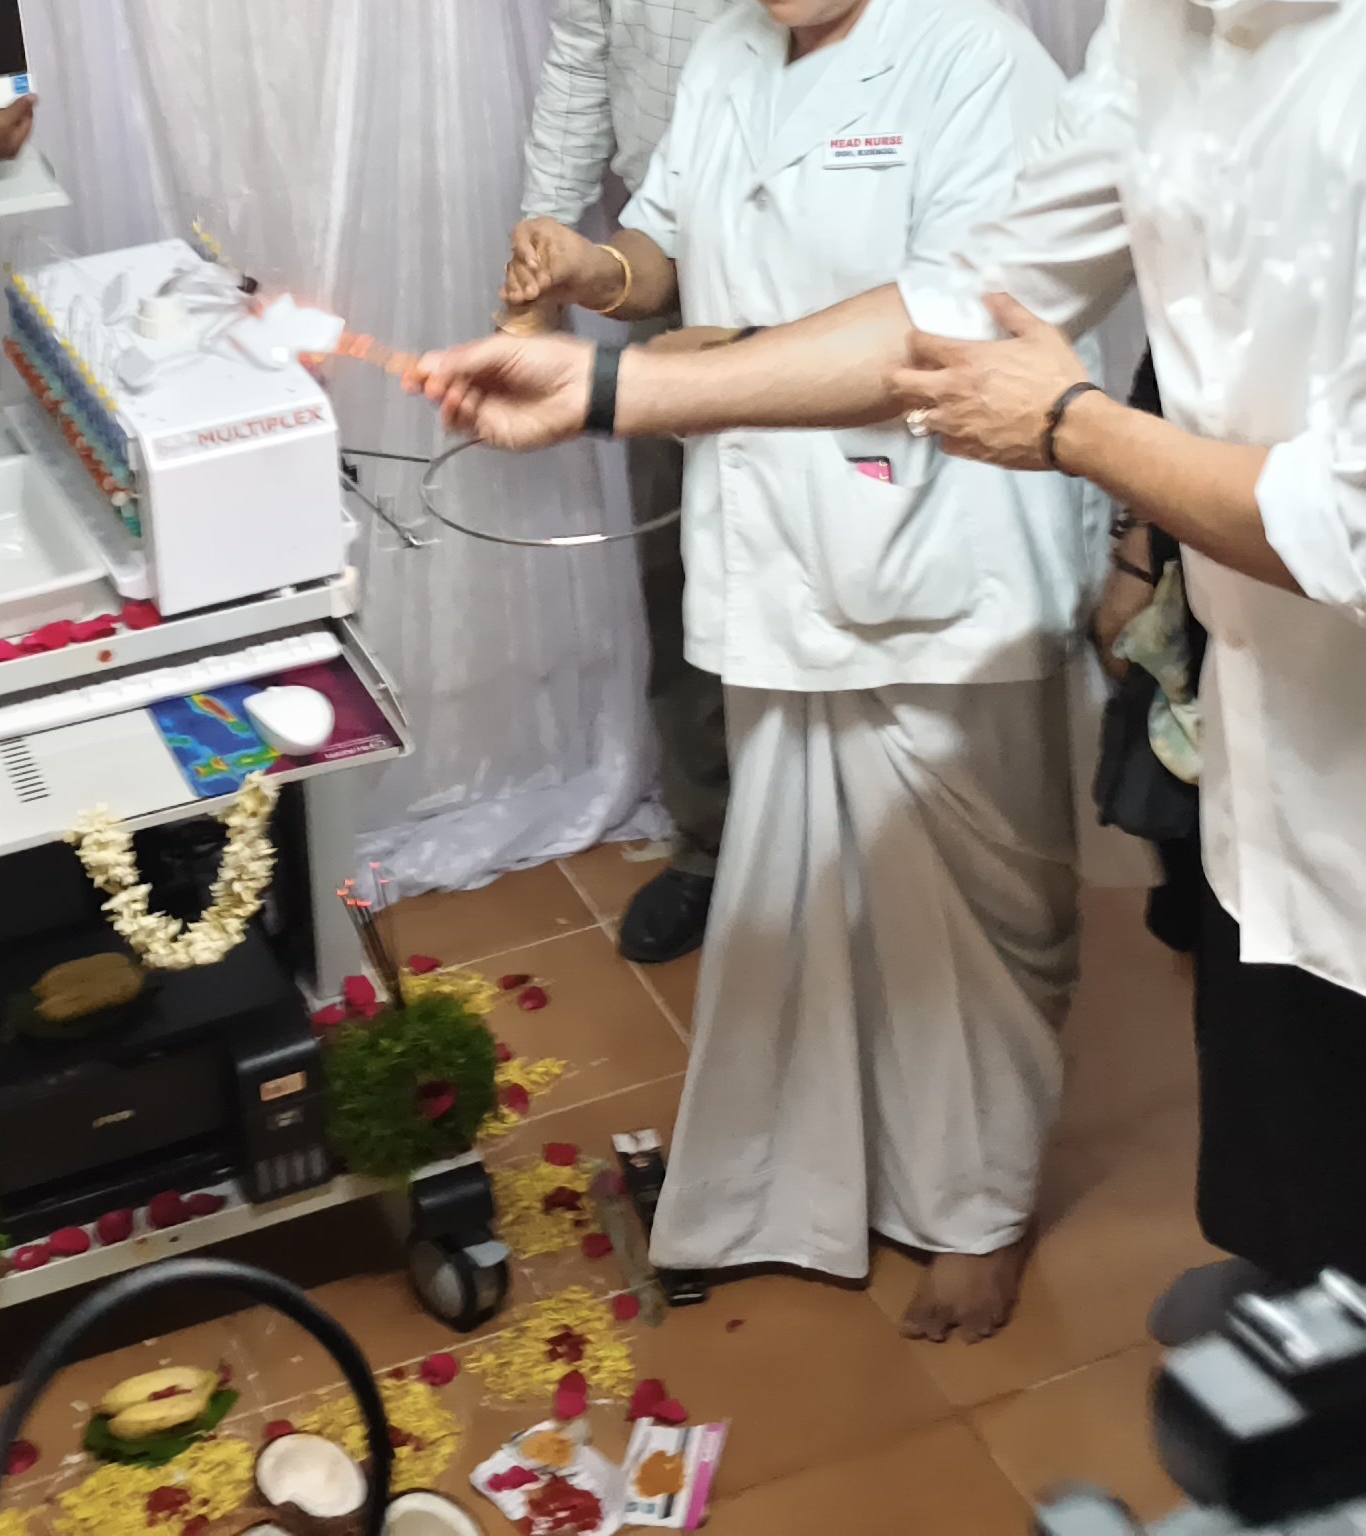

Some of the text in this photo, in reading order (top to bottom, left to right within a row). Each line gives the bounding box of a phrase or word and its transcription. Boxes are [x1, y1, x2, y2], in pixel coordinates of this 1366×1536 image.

[830, 135, 903, 148] HEAD NURSE
[197, 406, 325, 447] MULTIPLEX
